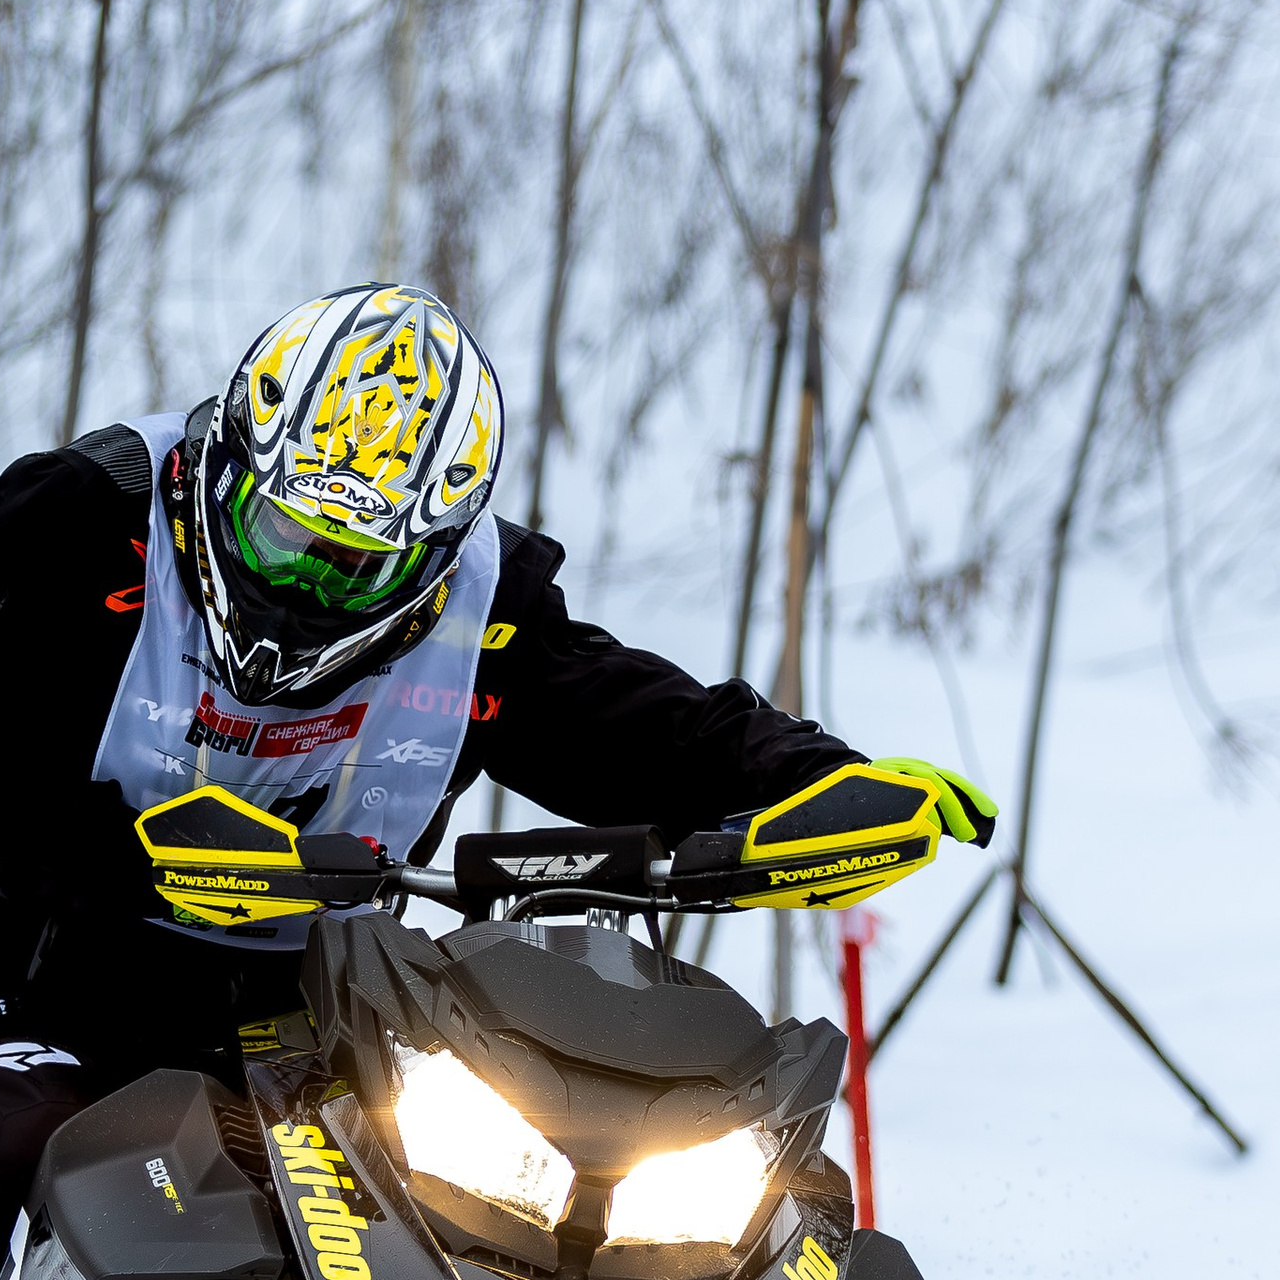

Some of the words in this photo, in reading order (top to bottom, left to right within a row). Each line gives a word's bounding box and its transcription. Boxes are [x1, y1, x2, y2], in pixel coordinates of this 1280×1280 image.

[299, 474, 387, 513] SUOMY
[389, 681, 503, 721] ROTAX
[375, 738, 454, 767] XPS
[492, 854, 610, 876] FLY
[518, 874, 583, 882] RACING
